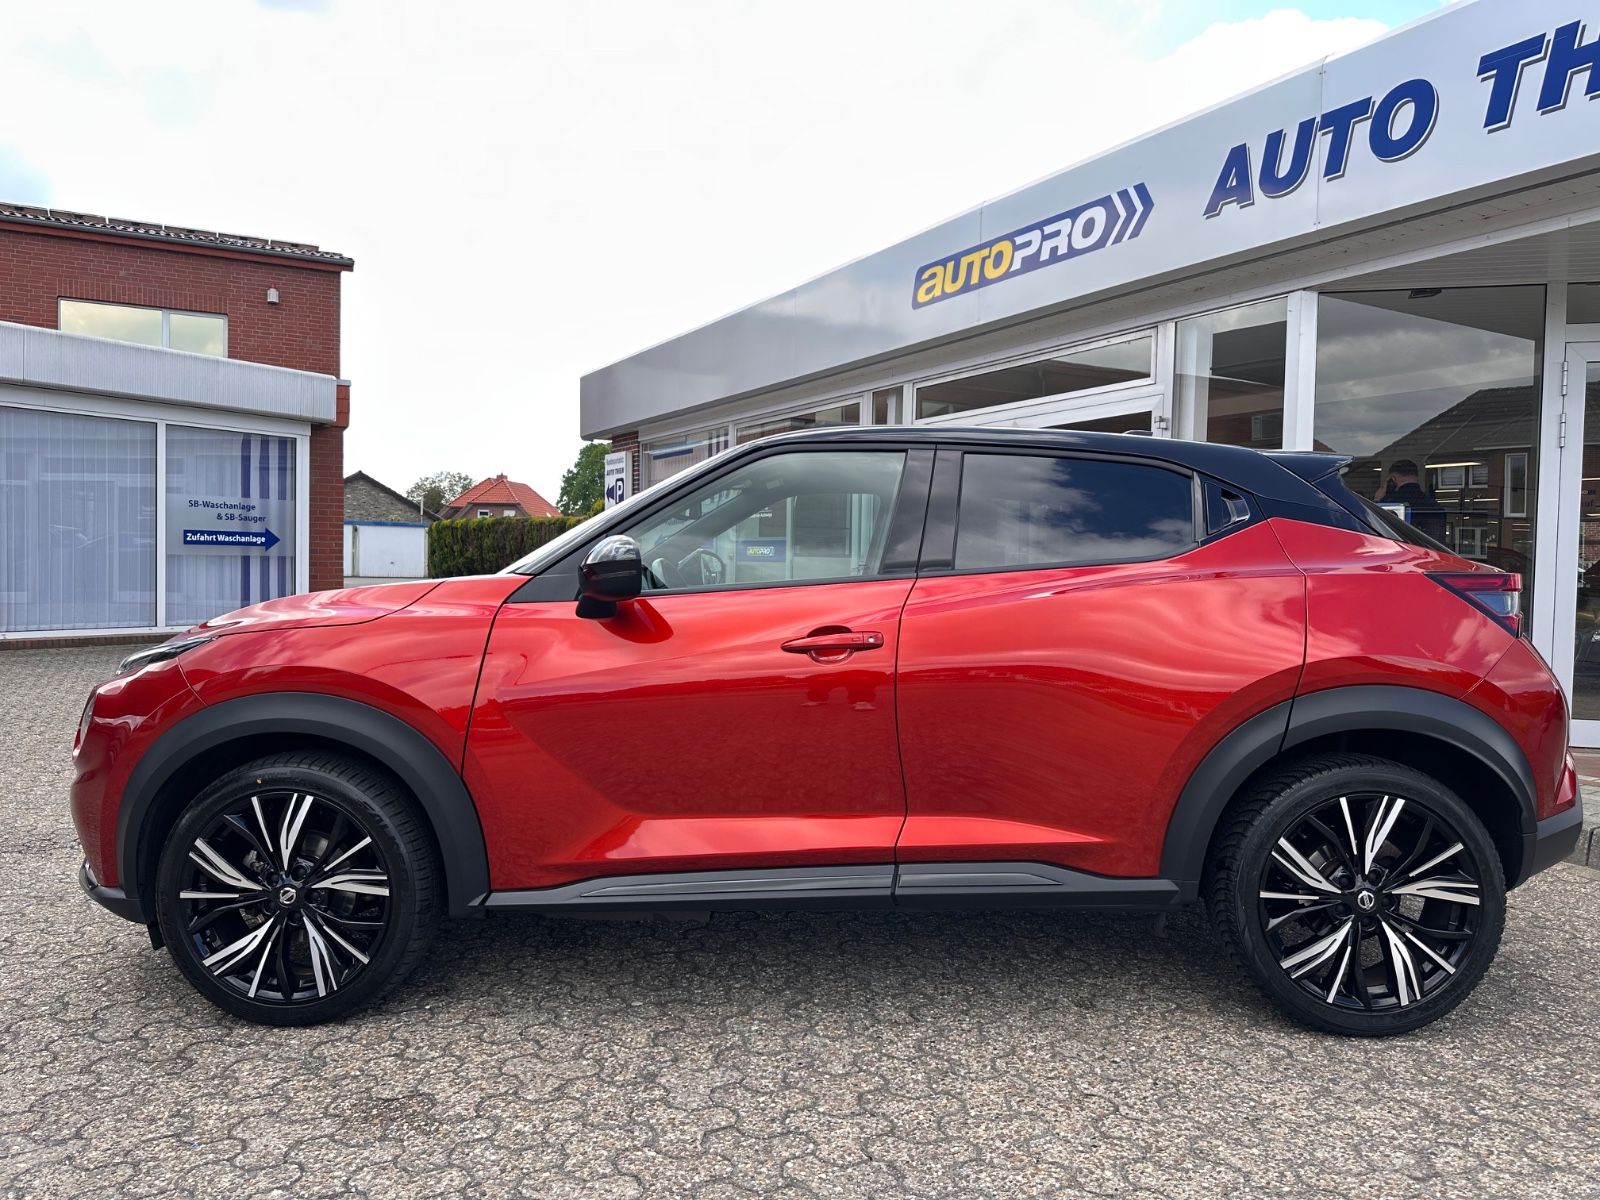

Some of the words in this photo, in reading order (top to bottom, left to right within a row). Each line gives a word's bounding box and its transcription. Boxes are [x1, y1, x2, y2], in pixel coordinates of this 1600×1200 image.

[1203, 78, 1439, 218] AUTO
[616, 480, 624, 503] P
[188, 500, 256, 512] SB-Waschanlage
[224, 513, 267, 523] SB-Sauger
[186, 533, 216, 541] Zufahrt
[217, 534, 266, 544] Waschanlage
